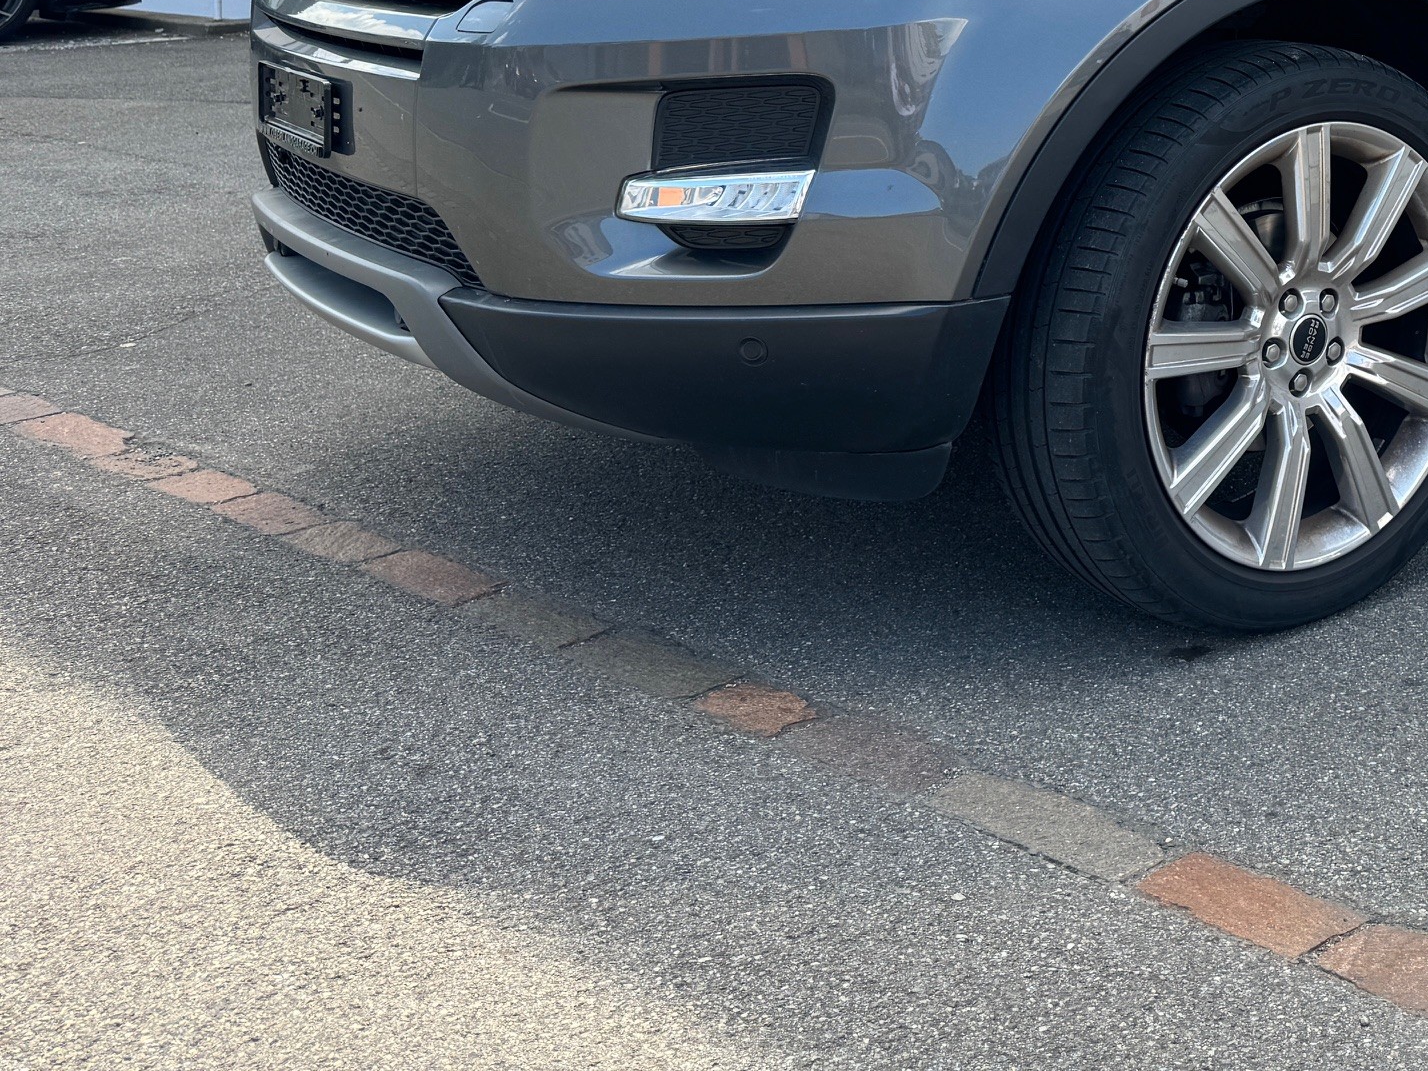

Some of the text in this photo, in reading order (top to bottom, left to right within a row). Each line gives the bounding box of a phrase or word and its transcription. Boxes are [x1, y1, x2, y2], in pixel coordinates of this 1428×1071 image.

[1302, 78, 1401, 104] ZERO
[1301, 319, 1316, 358] ROVER
[1305, 320, 1320, 359] RANGE
